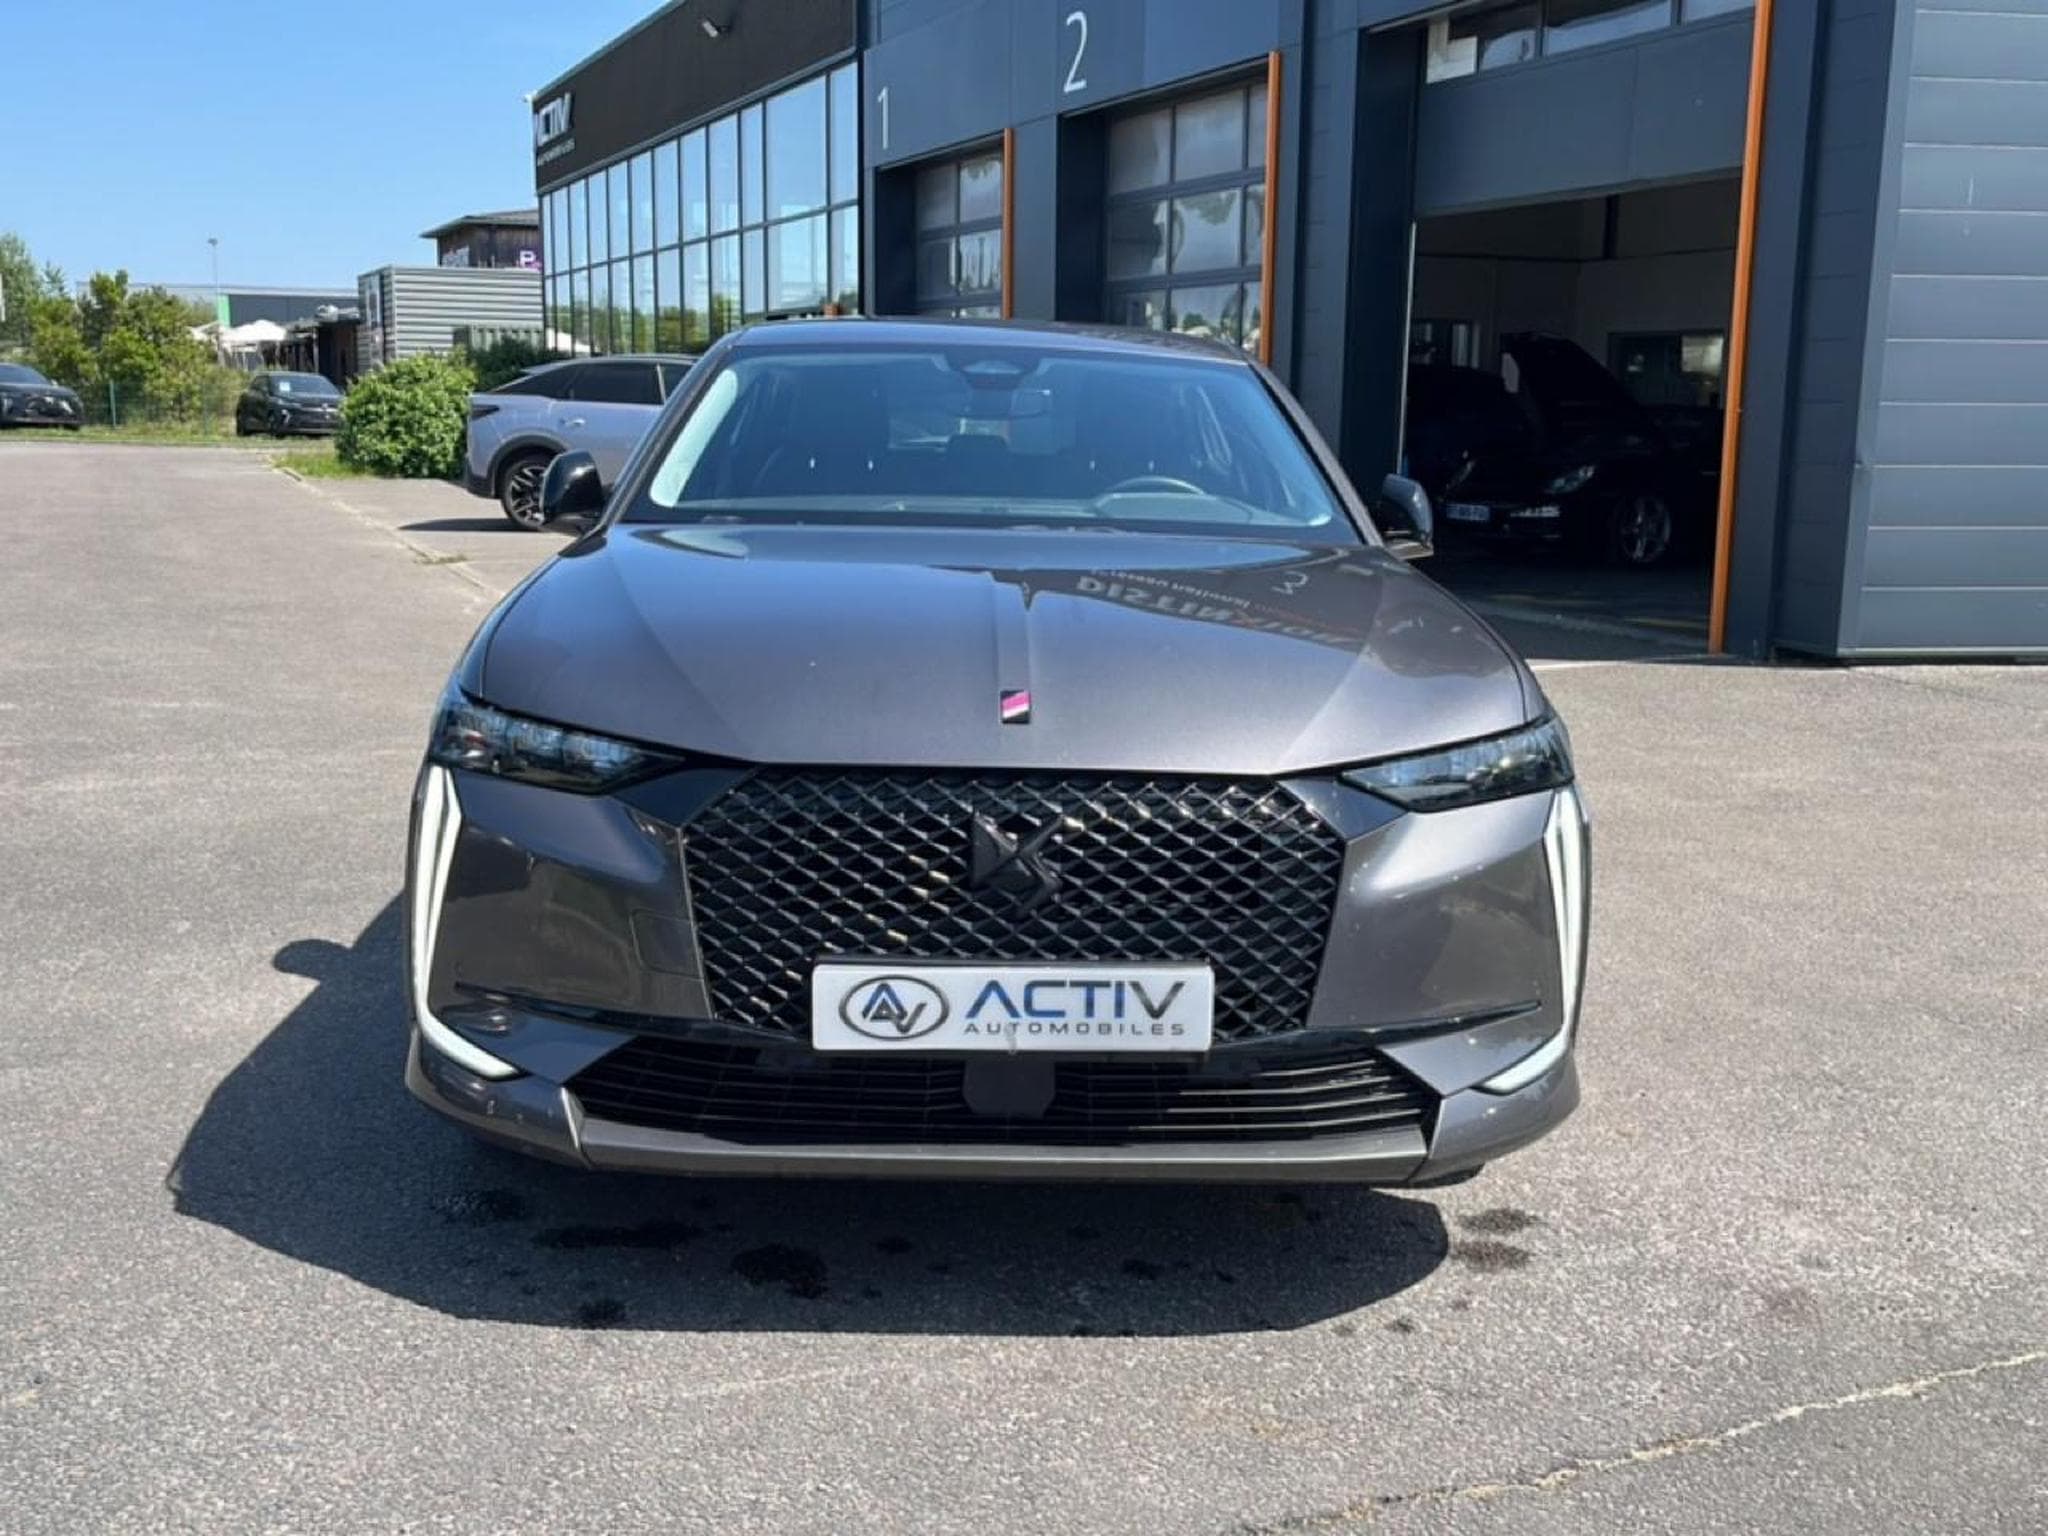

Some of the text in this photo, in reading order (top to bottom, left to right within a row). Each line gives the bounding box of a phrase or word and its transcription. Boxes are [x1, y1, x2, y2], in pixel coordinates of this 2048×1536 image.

[1063, 11, 1087, 93] 2
[533, 92, 570, 147] CTIV
[877, 86, 889, 149] 1
[966, 980, 1186, 1019] ACTIV
[964, 1022, 1185, 1036] AUTOMOBILES
